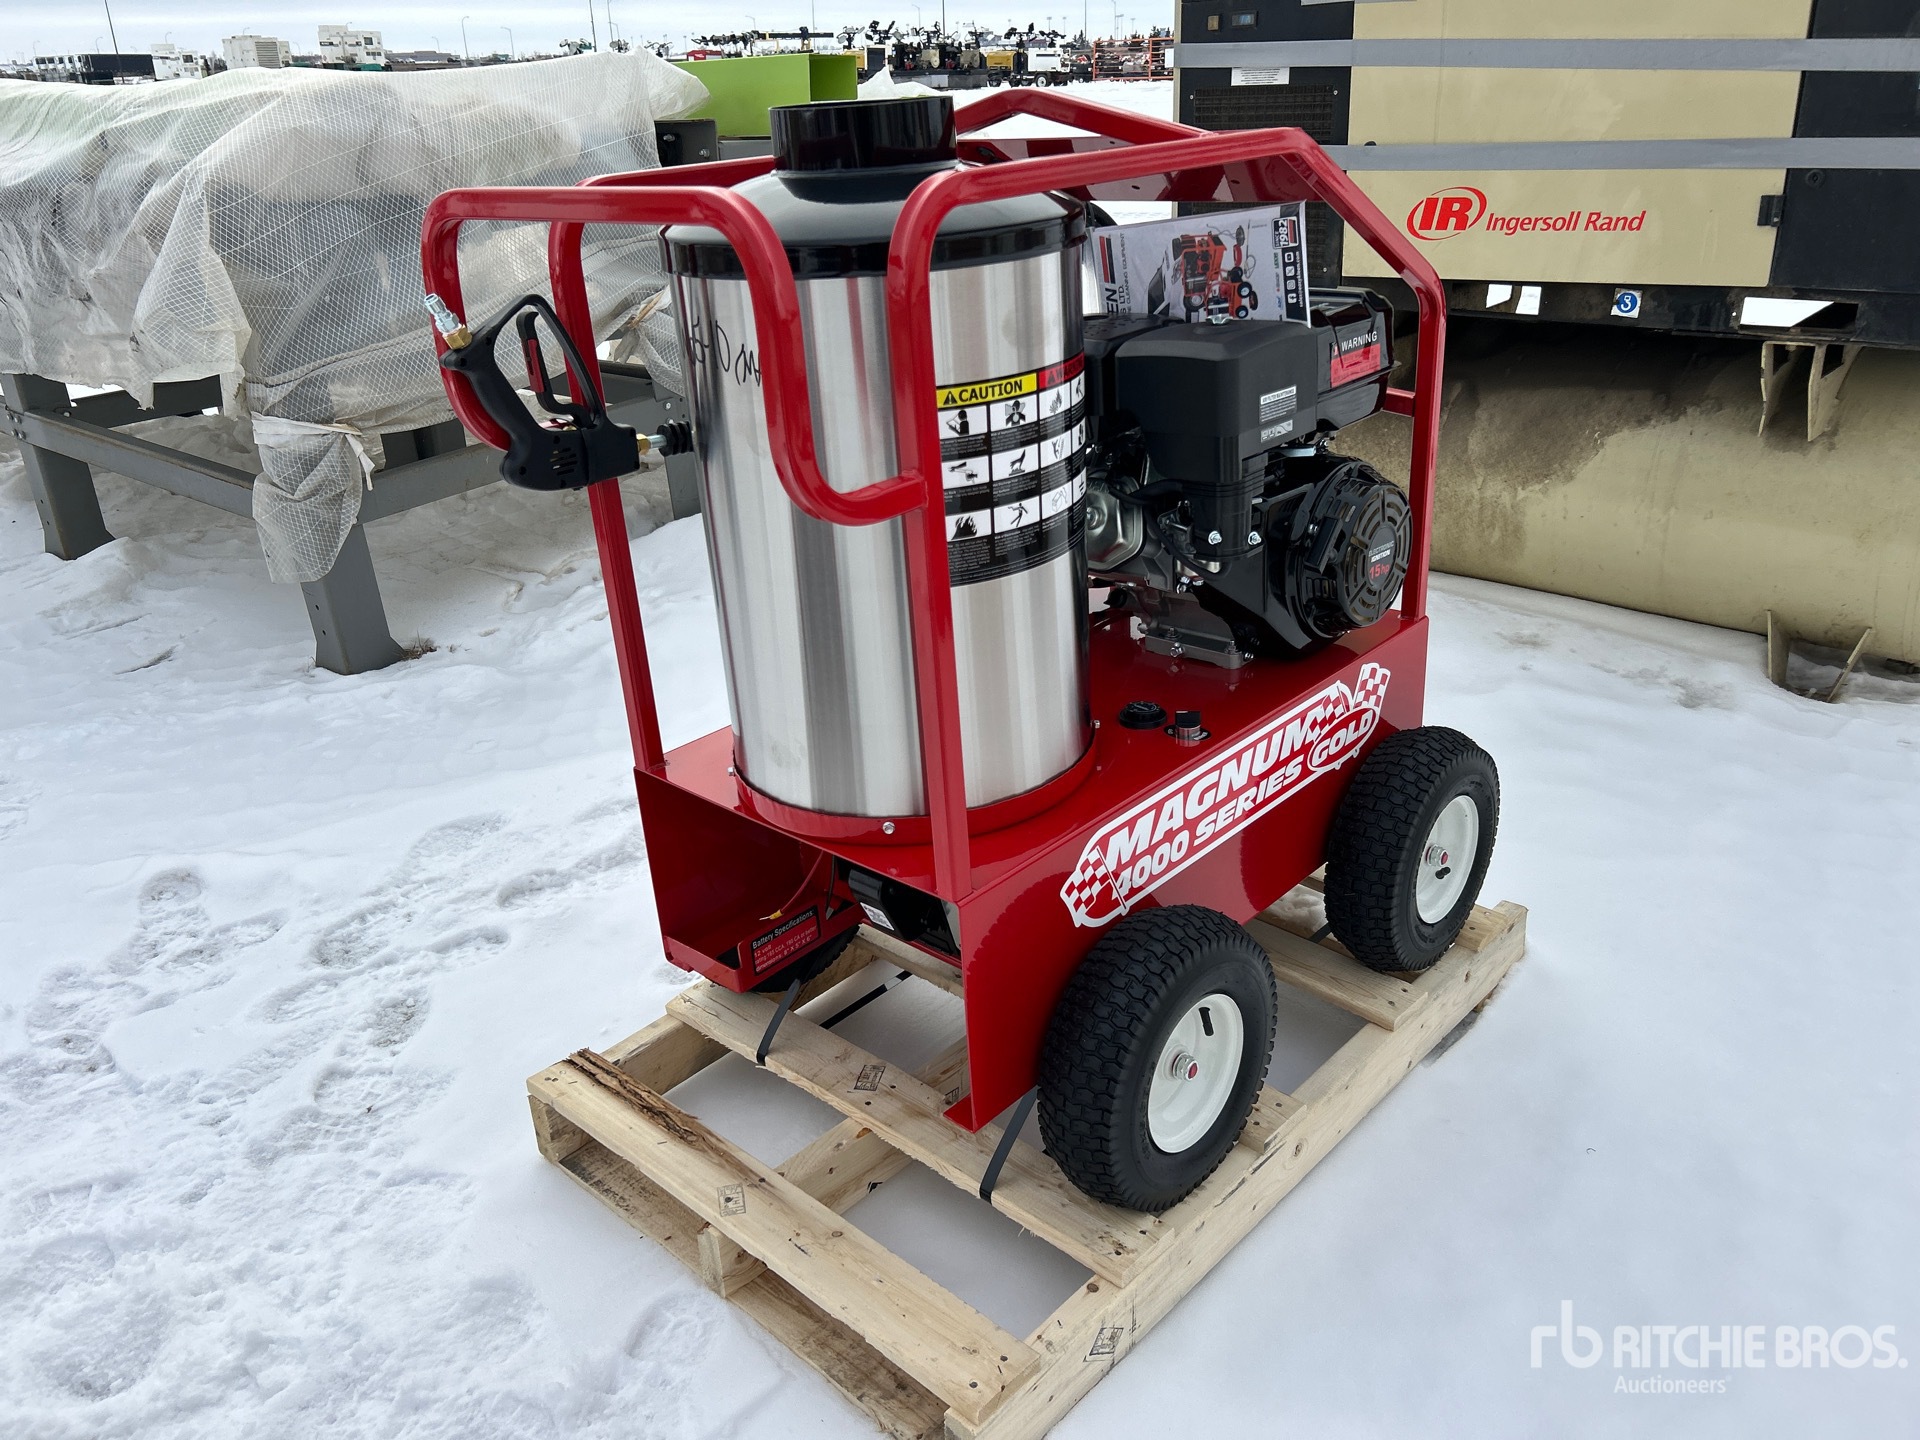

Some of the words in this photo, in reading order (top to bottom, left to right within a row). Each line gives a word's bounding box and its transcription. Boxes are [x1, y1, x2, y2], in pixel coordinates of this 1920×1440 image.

[1418, 197, 1473, 231] IR
[1486, 211, 1581, 236] Ingersoll
[1583, 210, 1647, 232] Rand
[1278, 219, 1289, 247] 1982
[1341, 331, 1378, 352] WARNING
[958, 379, 1023, 403] CAUTION
[1312, 712, 1371, 767] GOLD
[1103, 702, 1326, 871] MAGNUM
[1112, 830, 1190, 900] 4000
[1193, 754, 1304, 847] SERIES
[752, 932, 774, 950] Battery
